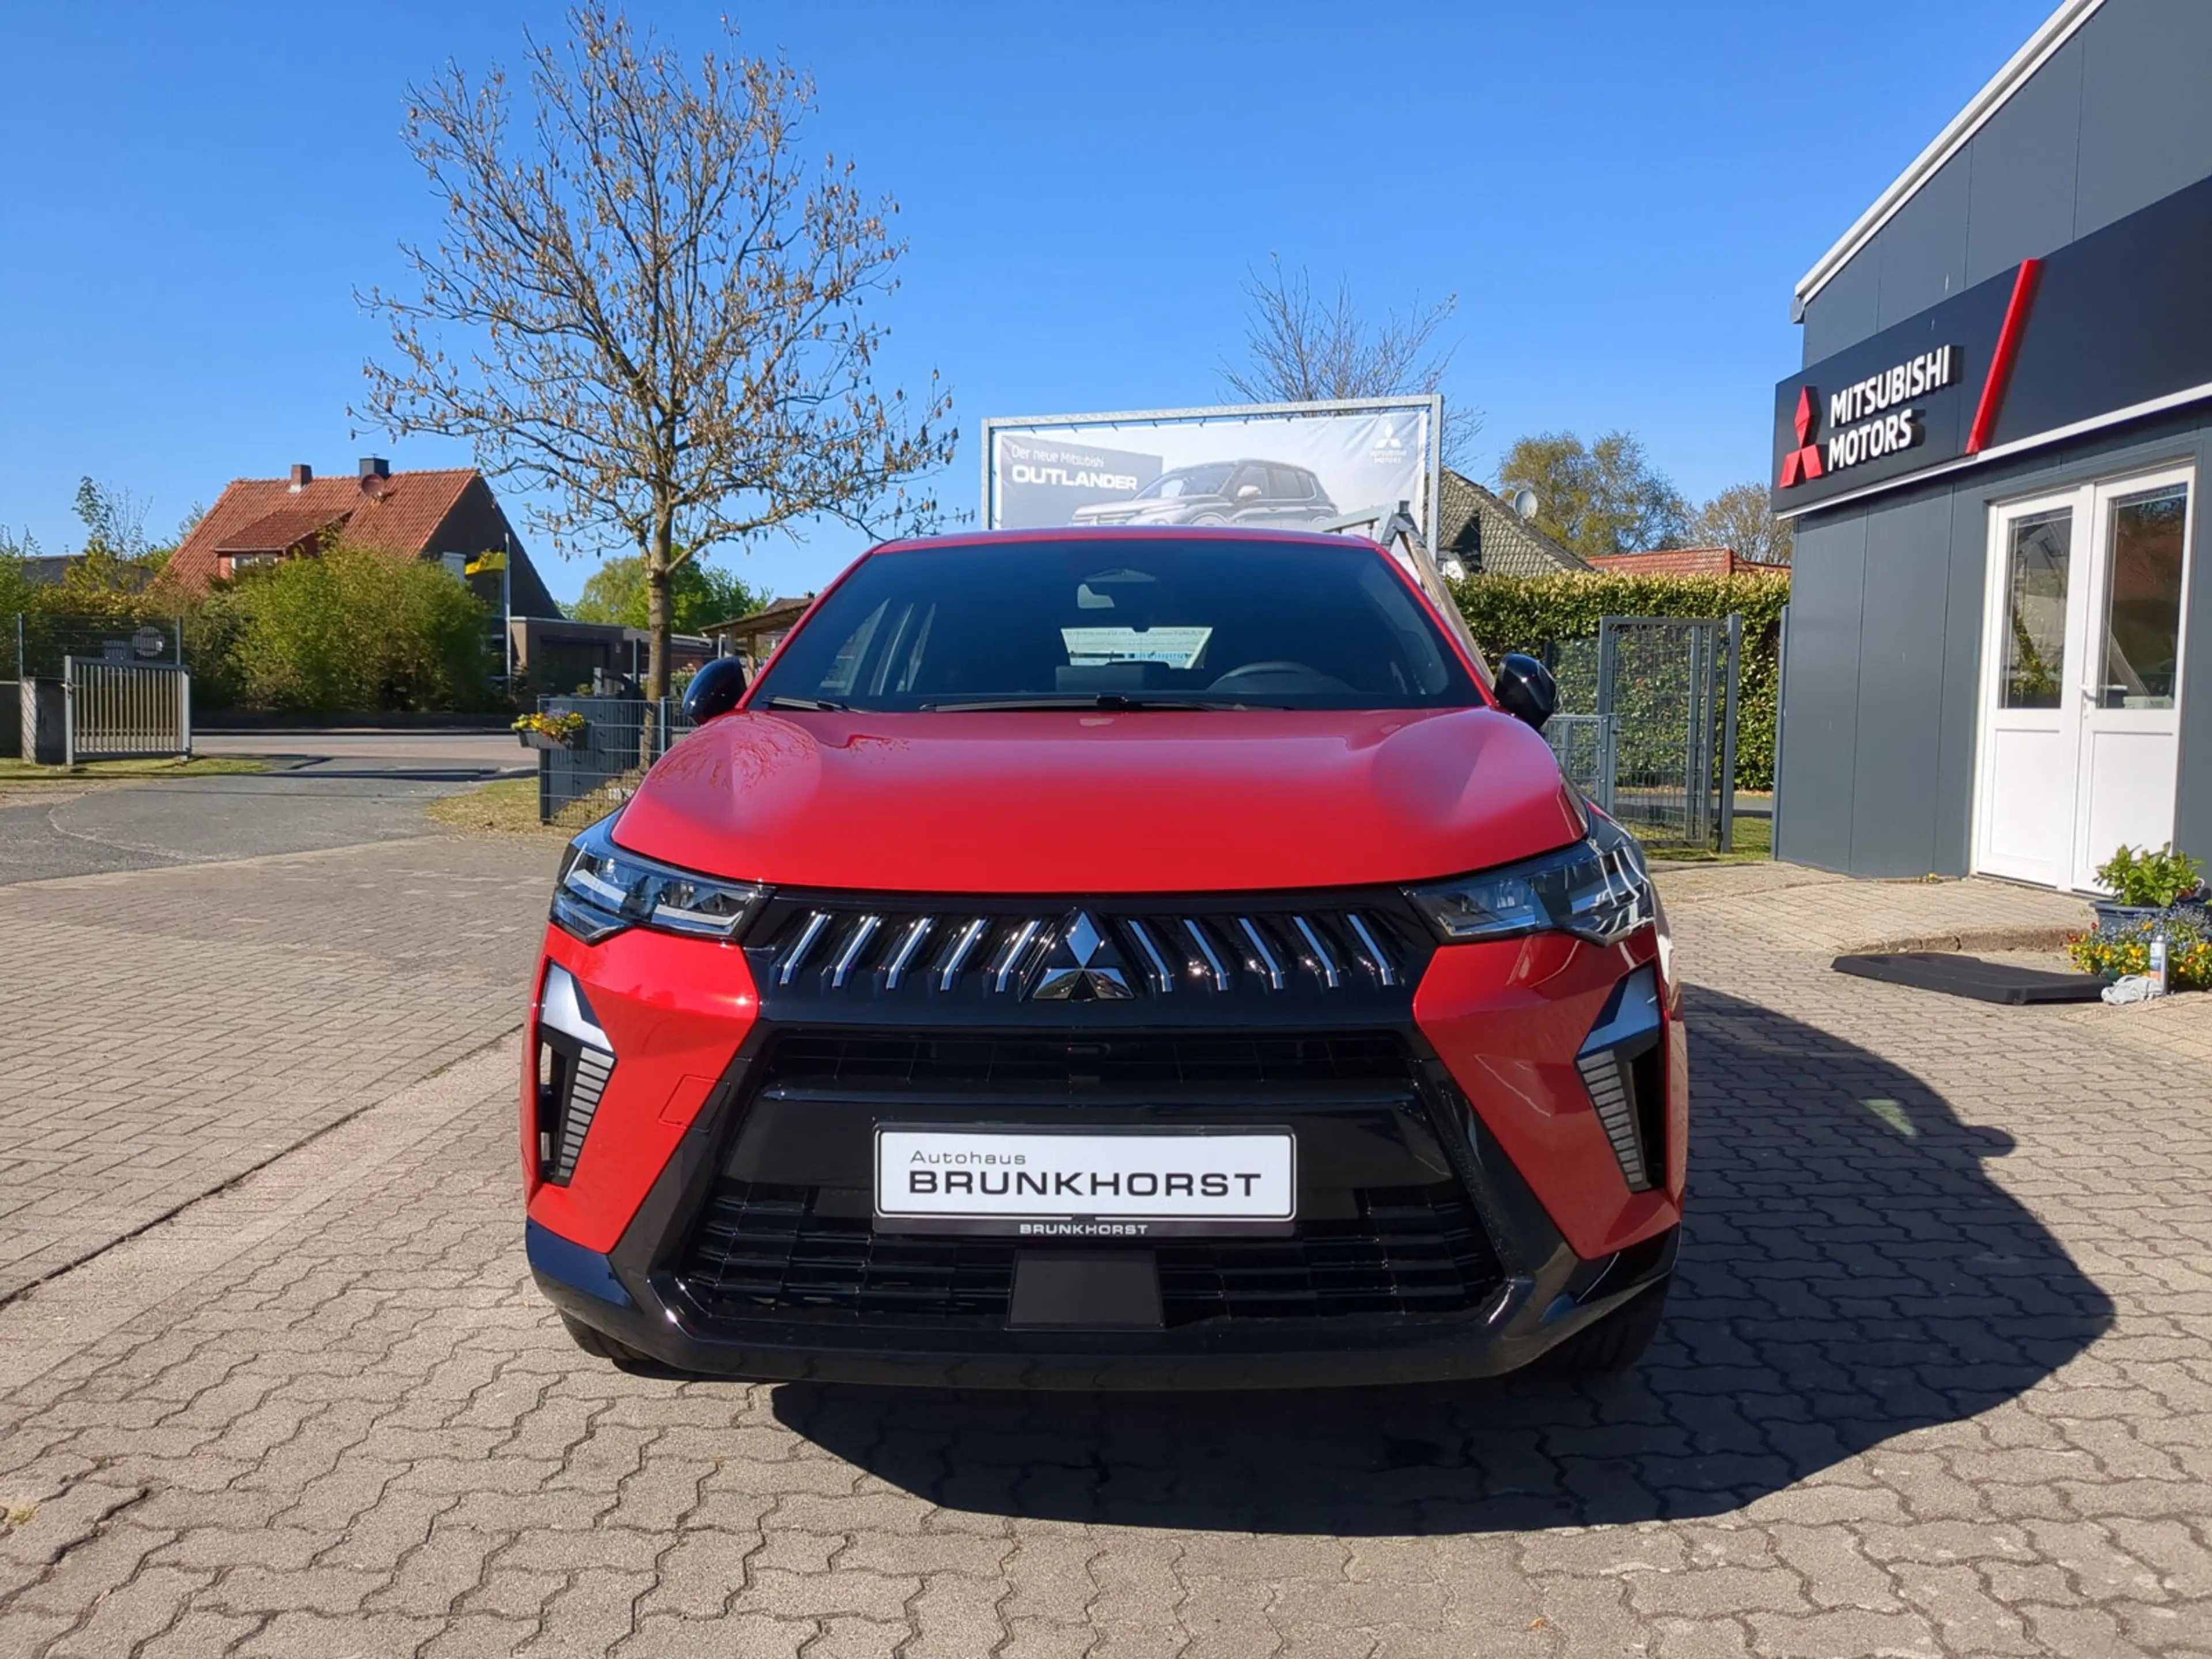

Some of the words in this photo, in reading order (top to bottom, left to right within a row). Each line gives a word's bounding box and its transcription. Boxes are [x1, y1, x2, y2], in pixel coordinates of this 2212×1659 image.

[1830, 344, 1950, 428] MITSUBISHI
[1828, 408, 1912, 472] MOTORS
[1012, 444, 1031, 460] Der
[1033, 450, 1059, 463] neue
[1012, 464, 1138, 490] OUTLANDER
[910, 1150, 1027, 1165] Autohaus
[909, 1170, 1262, 1197] BRUNKHORST
[1019, 1224, 1149, 1235] BRUNKHORST
